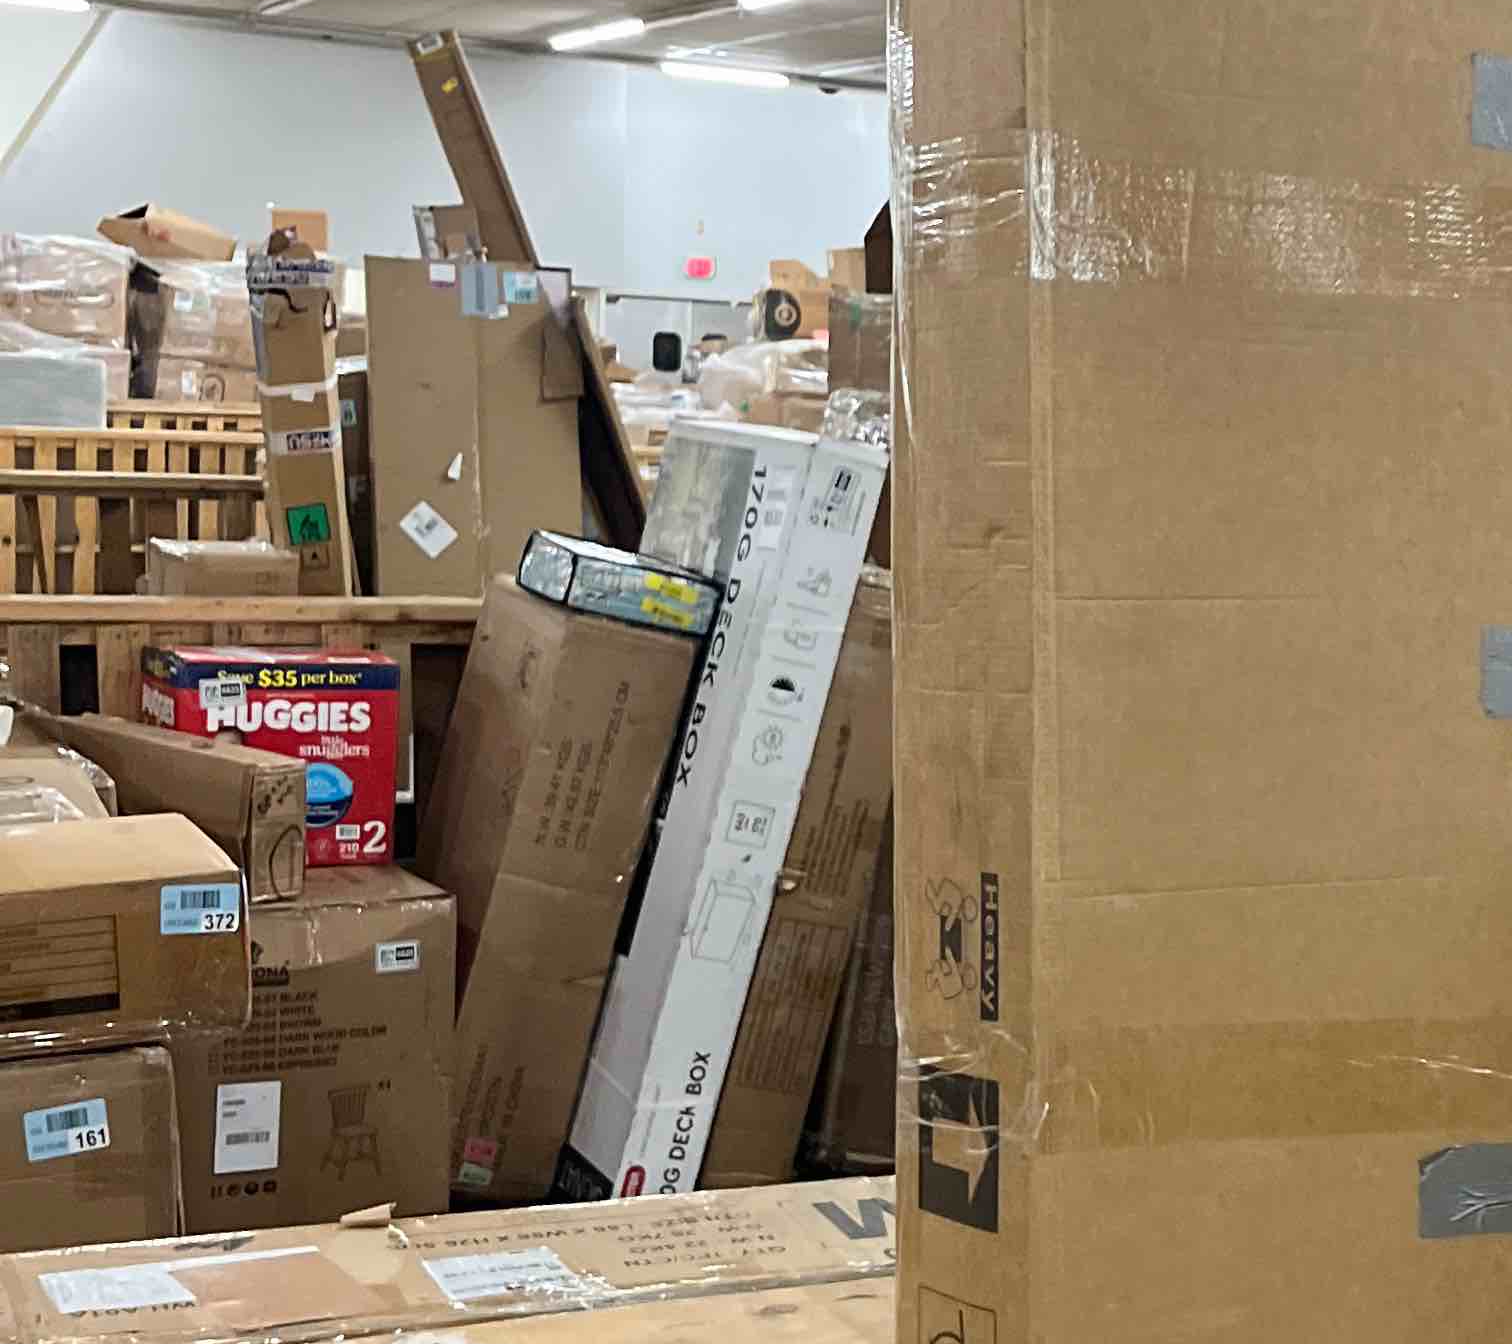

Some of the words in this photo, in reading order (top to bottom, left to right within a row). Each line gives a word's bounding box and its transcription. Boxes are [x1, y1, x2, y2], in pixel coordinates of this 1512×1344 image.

[736, 464, 768, 563] 170G
[701, 577, 742, 688] DECK
[258, 669, 298, 688] $35
[301, 673, 325, 686] per
[206, 699, 371, 733] HUGGIES
[676, 702, 707, 787] BOX
[362, 820, 387, 854] 2
[204, 913, 235, 931] 372
[982, 885, 997, 1011] Heavy
[668, 1104, 697, 1161] DECK
[686, 1052, 711, 1095] BOX
[76, 1128, 106, 1148] 161
